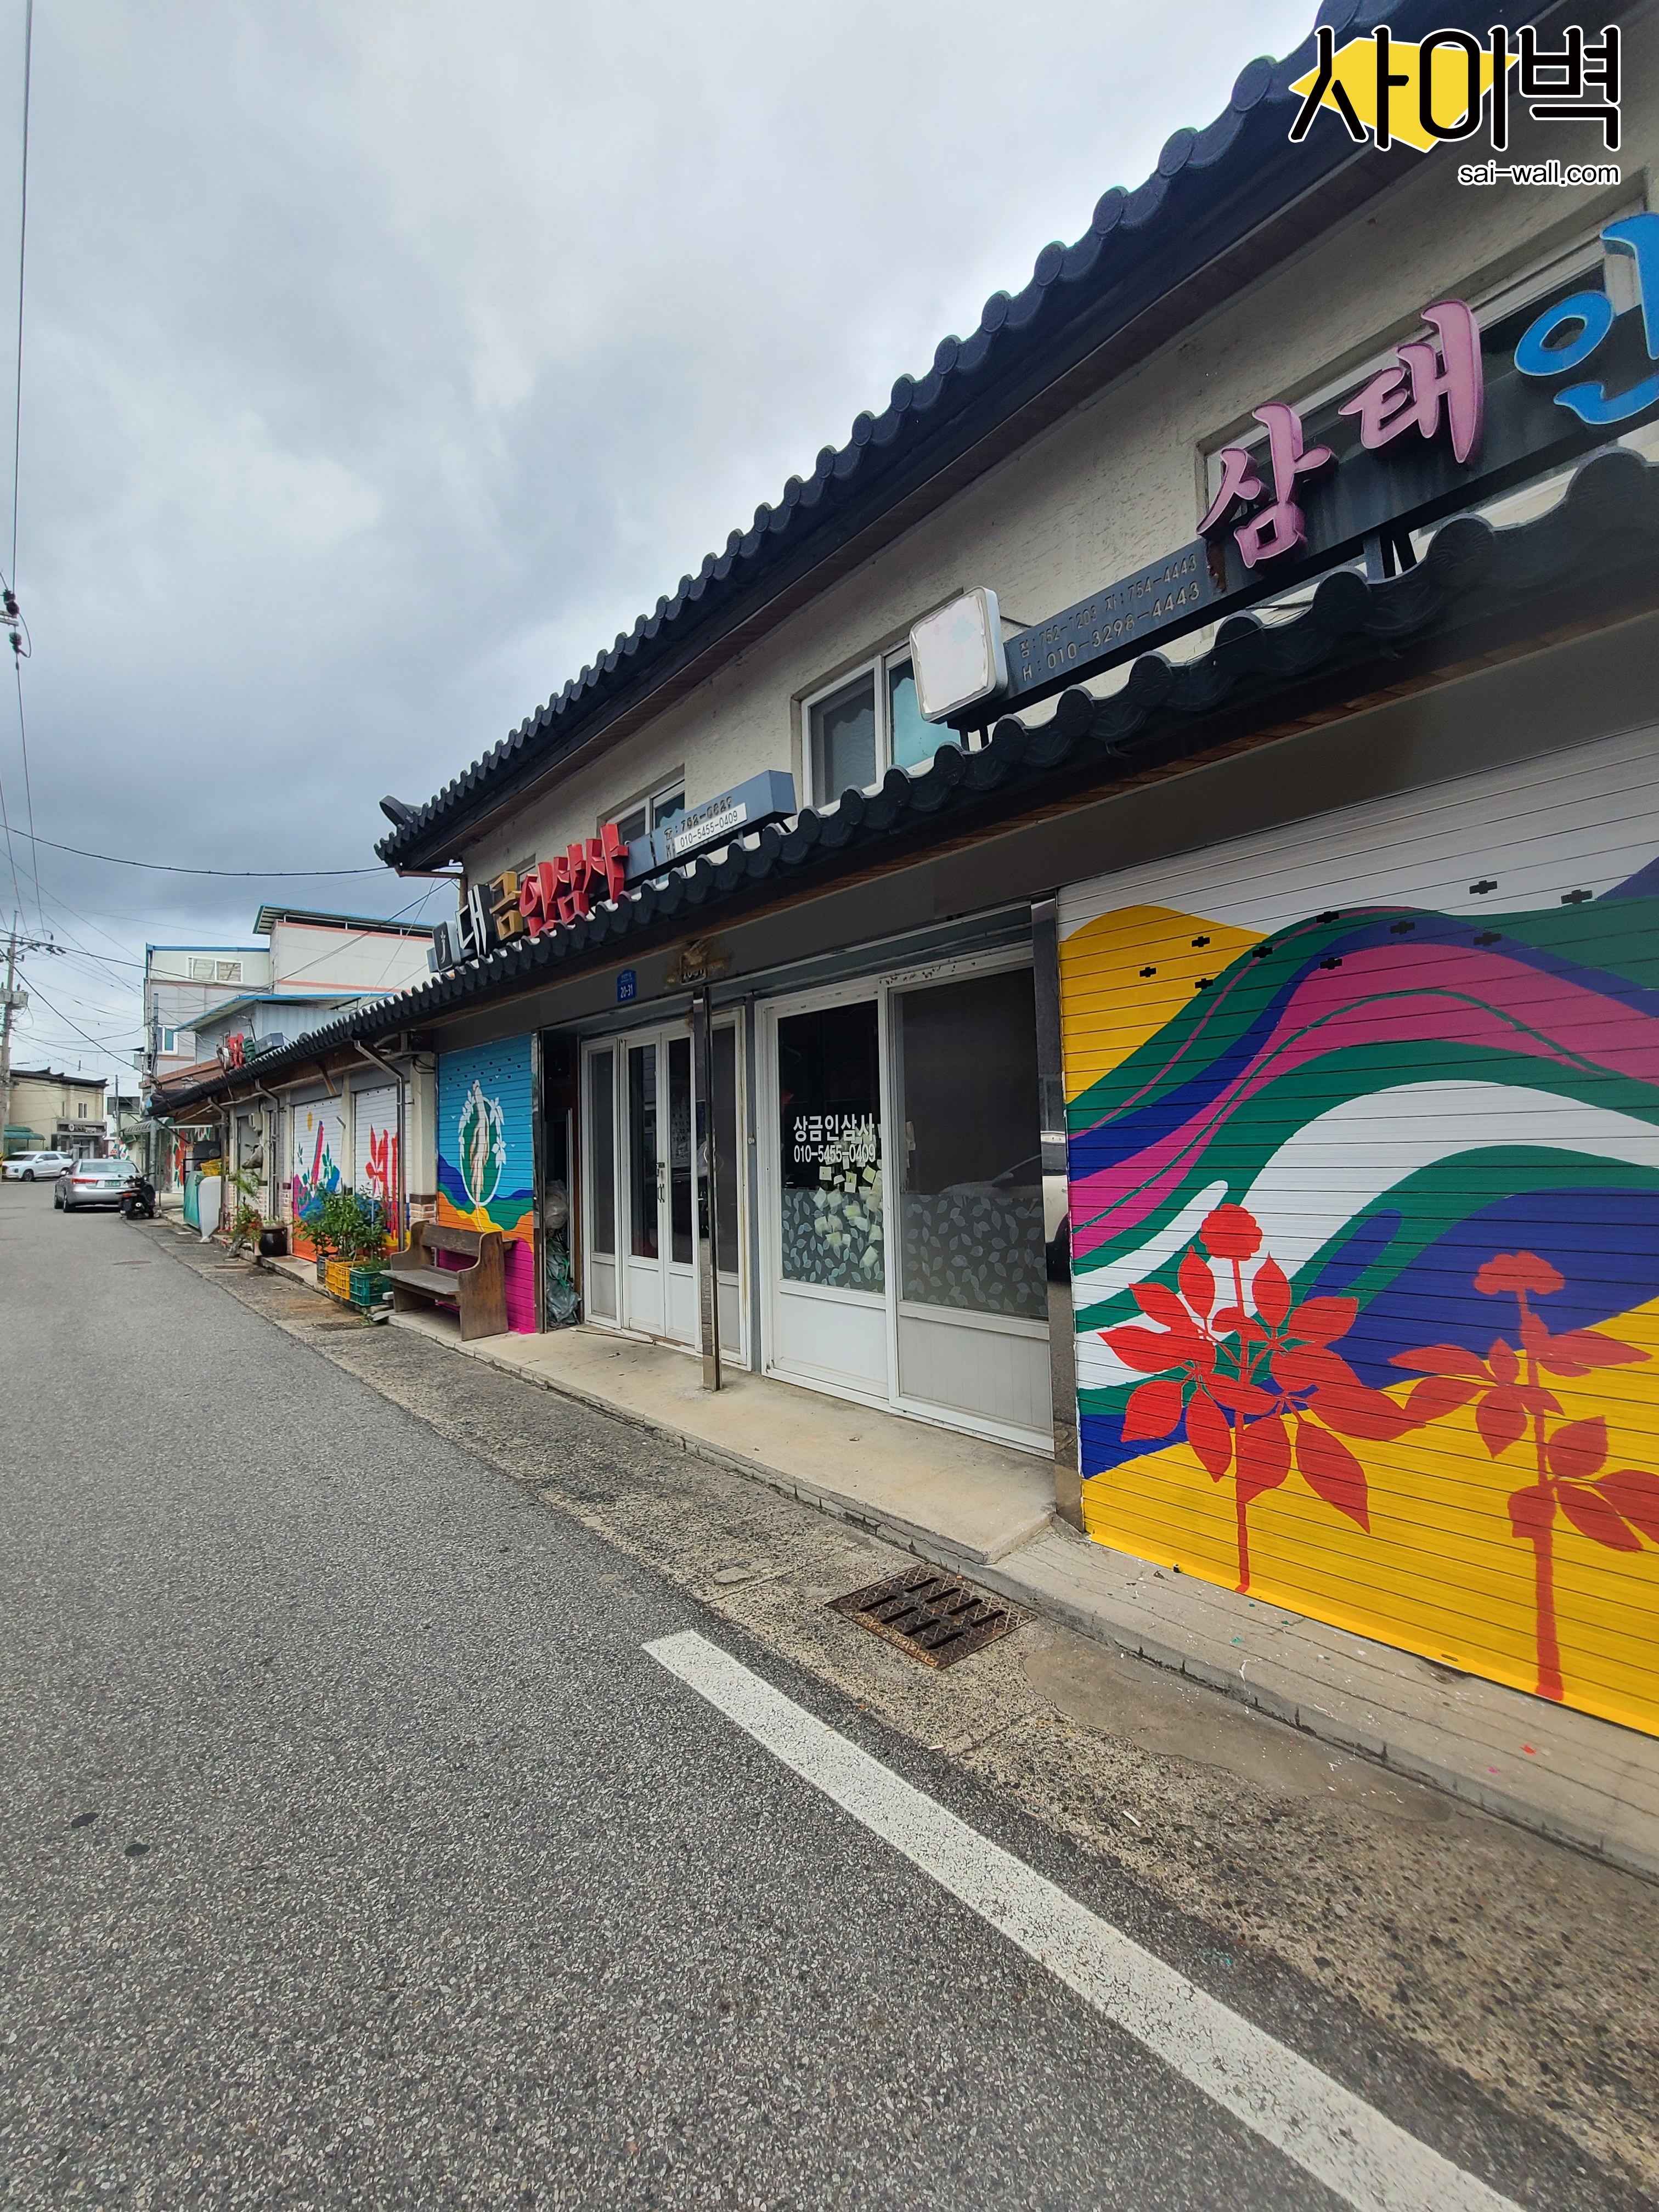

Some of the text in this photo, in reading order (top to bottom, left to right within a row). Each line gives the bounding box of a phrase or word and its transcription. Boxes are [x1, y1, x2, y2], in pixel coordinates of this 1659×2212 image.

[1128, 554, 1197, 602] 754-4443
[1046, 581, 1200, 669] 010-3298-4443
[680, 810, 738, 848] 010-5455-0409
[620, 984, 633, 998] 20-31
[793, 1113, 874, 1142] 상금인삼사
[793, 1143, 876, 1163] 010-5455-0409
